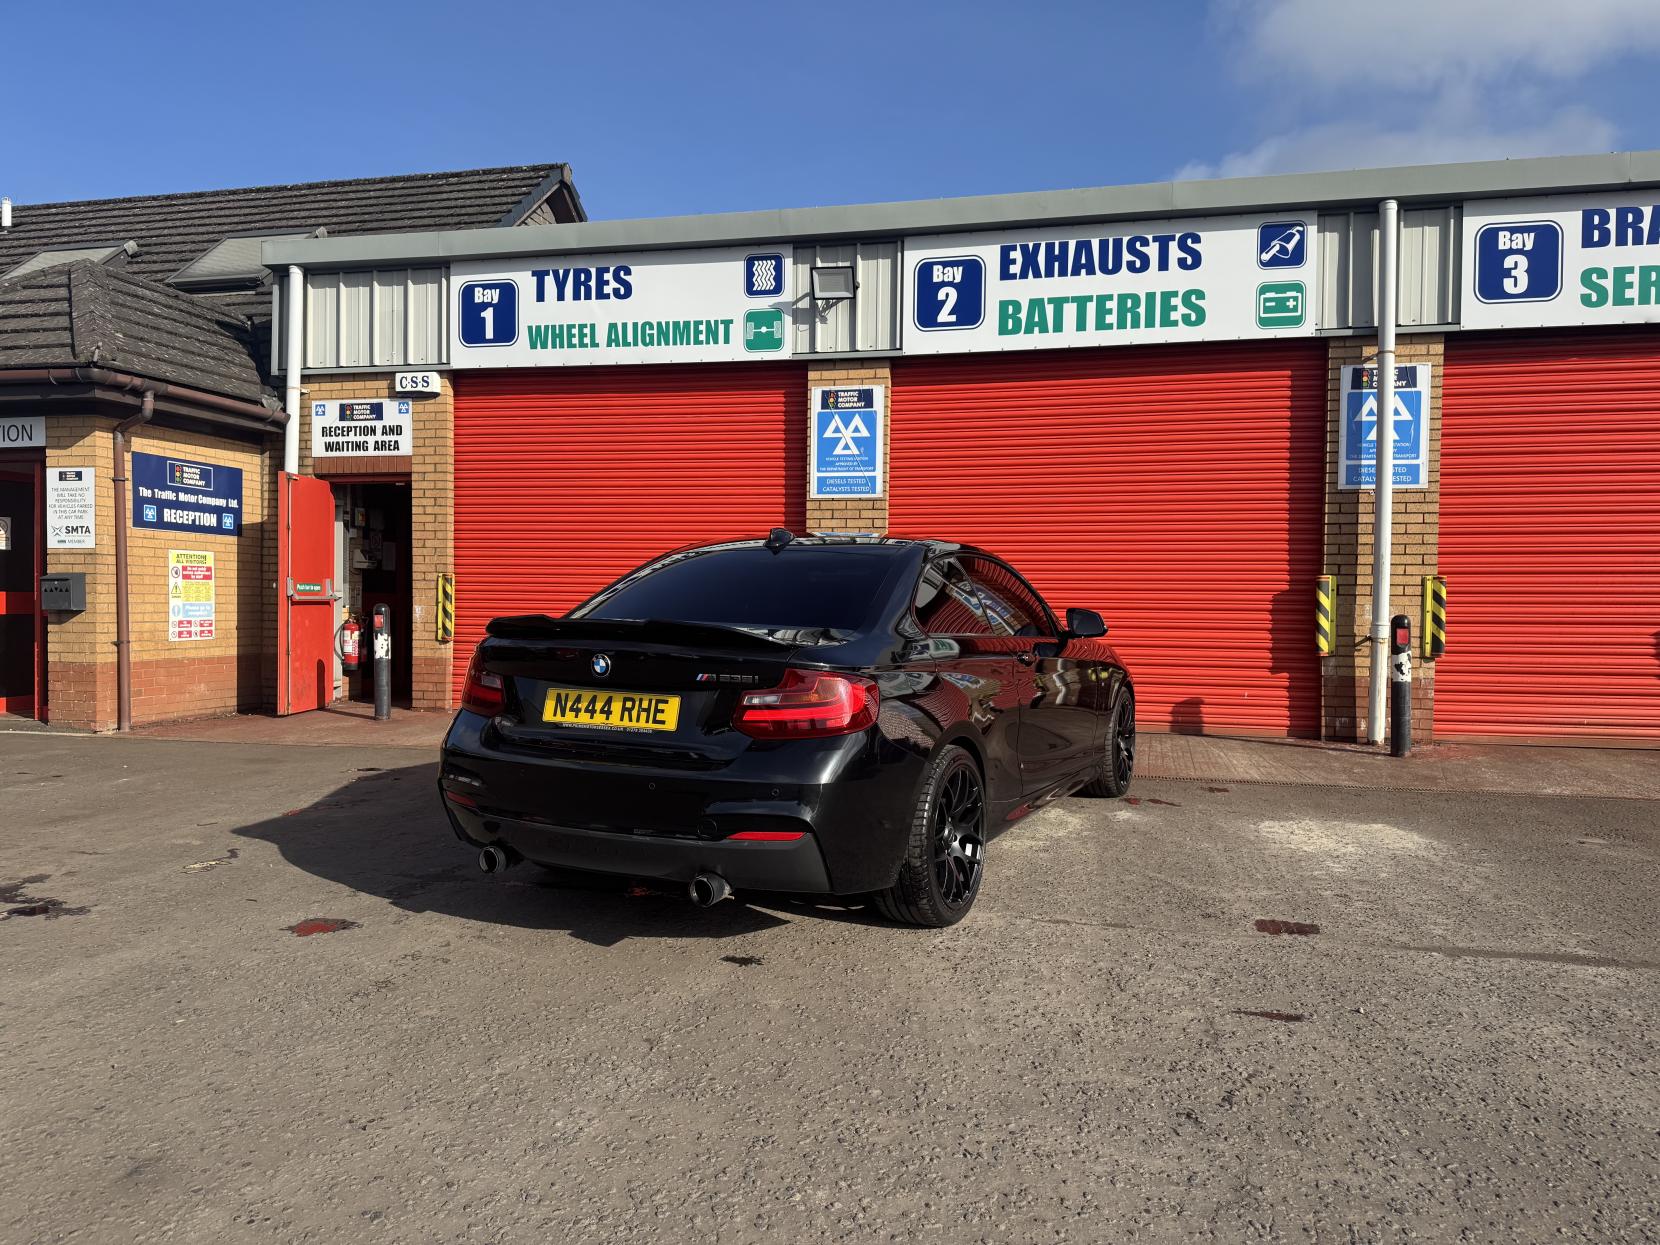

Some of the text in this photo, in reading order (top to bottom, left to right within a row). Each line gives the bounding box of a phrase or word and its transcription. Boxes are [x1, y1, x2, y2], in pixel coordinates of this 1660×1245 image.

[1498, 231, 1535, 251] Bay
[1000, 232, 1202, 281] EXHAUSTS
[531, 265, 633, 302] TYRES
[932, 265, 963, 283] Bay
[1503, 254, 1529, 295] 3
[474, 287, 500, 304] Bay
[1580, 265, 1660, 308] SER
[937, 286, 958, 323] 2
[998, 288, 1207, 336] BATTERIES
[480, 307, 494, 340] 1
[527, 319, 734, 350] WHEEL ALIGNMENT
[0, 424, 33, 442] ION
[321, 424, 403, 437] RECEPTION AND
[324, 440, 400, 452] WAITING AREA
[183, 466, 200, 474] TRAFFIC
[183, 478, 205, 486] COMPANY
[138, 487, 152, 497] The
[154, 489, 177, 501] Traffic
[179, 492, 198, 503] Motor
[198, 494, 227, 507] Company
[163, 508, 218, 527] RECEPTION
[65, 526, 91, 534] SMTA
[553, 692, 670, 725] N444 RHE
